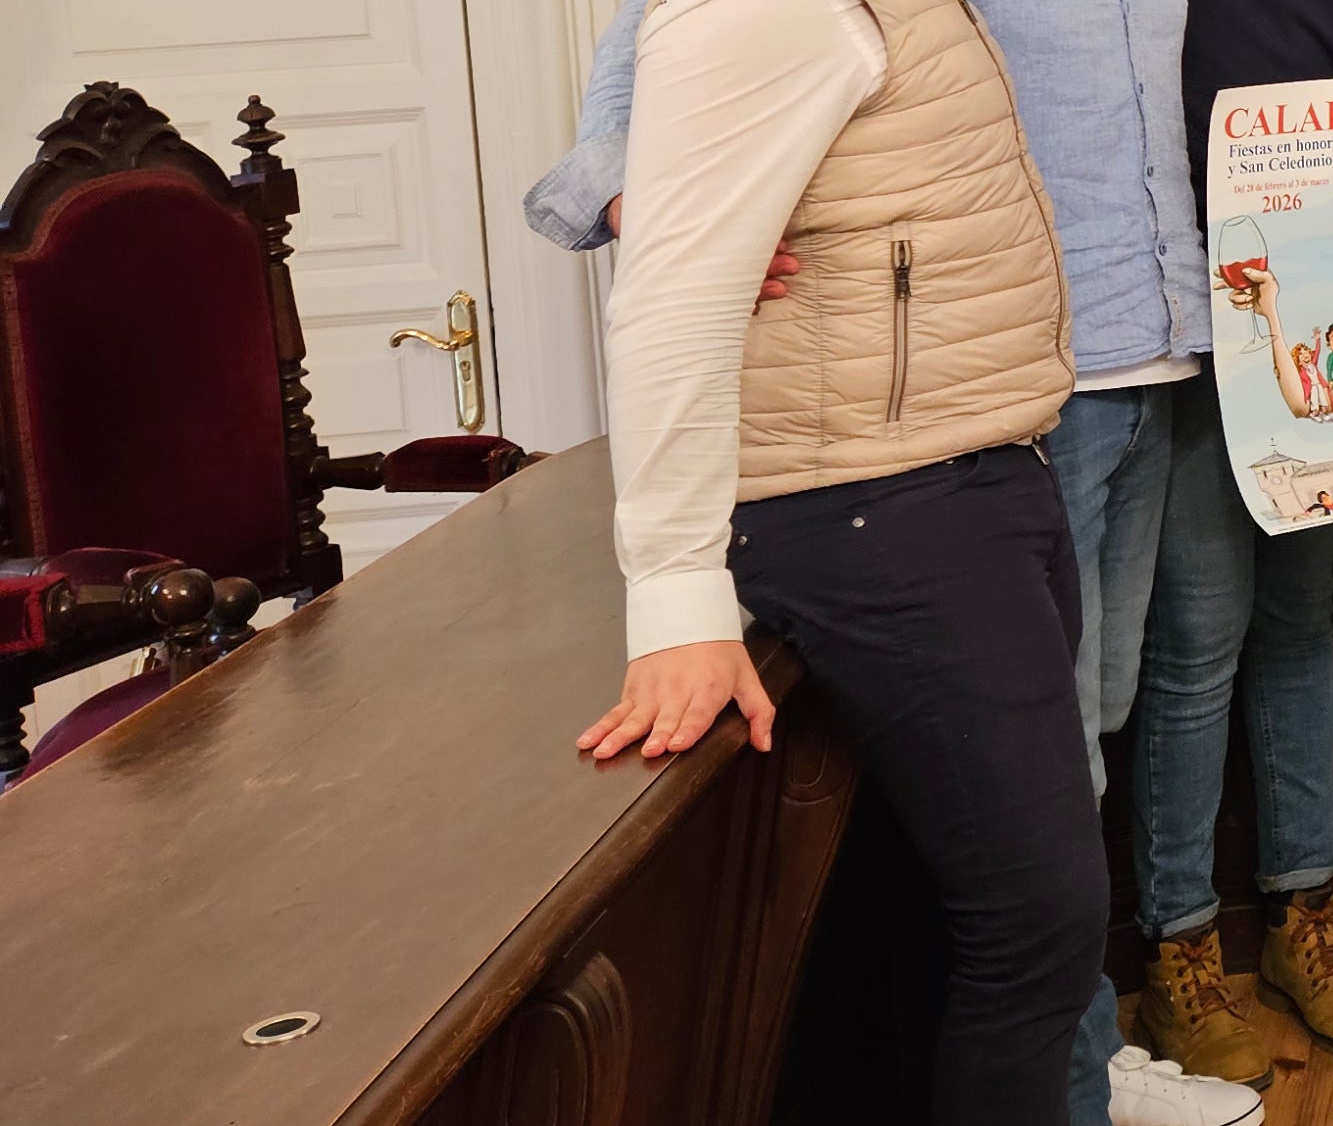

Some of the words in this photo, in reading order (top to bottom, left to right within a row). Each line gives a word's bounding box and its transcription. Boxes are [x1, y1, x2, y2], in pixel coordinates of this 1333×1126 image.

[1229, 144, 1272, 158] Fiestas
[1277, 143, 1291, 153] en
[1296, 139, 1333, 151] honor
[1227, 165, 1235, 178] y
[1240, 161, 1263, 174] San
[1269, 154, 1332, 171] Celedonio
[1234, 185, 1245, 194] Del
[1262, 193, 1302, 213] 2026
